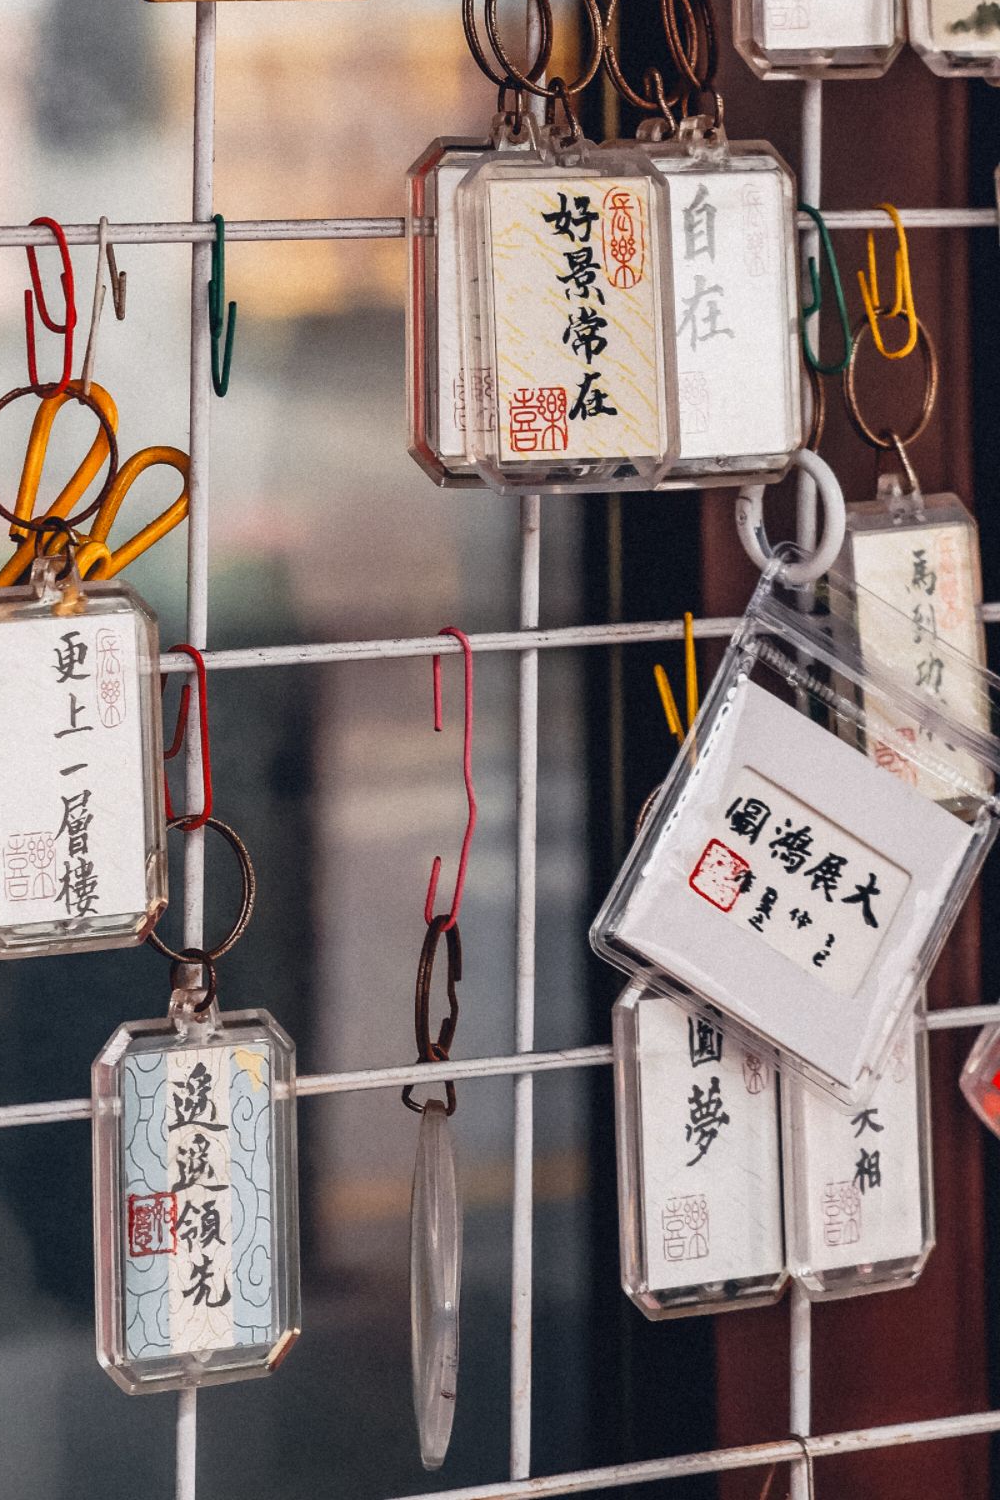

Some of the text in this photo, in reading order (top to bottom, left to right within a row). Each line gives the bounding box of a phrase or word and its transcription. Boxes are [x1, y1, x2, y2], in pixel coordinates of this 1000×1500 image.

[541, 191, 619, 422] 好景常在
[676, 183, 735, 353] 自在
[51, 630, 101, 919] 更上一層樓
